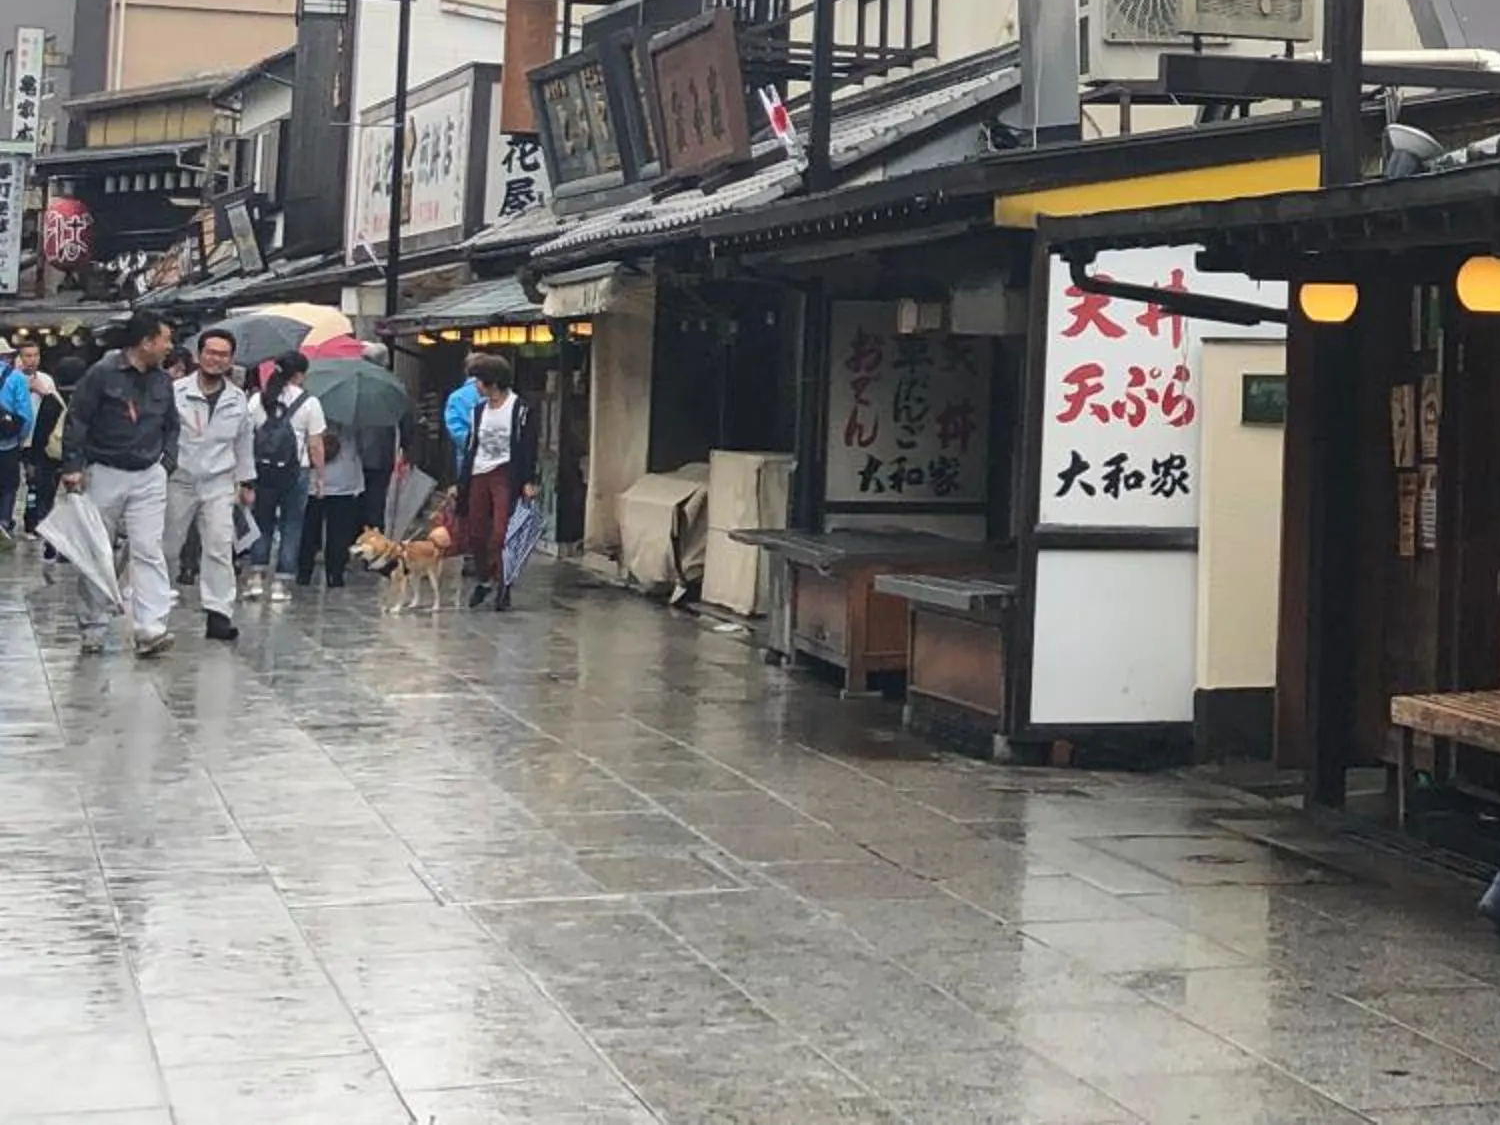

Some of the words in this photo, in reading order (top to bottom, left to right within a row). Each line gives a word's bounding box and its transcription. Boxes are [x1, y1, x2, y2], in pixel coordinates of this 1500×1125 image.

[1056, 363, 1195, 427] 天ぷら
[858, 454, 962, 497] 大和家
[1055, 450, 1190, 499] 大和家
